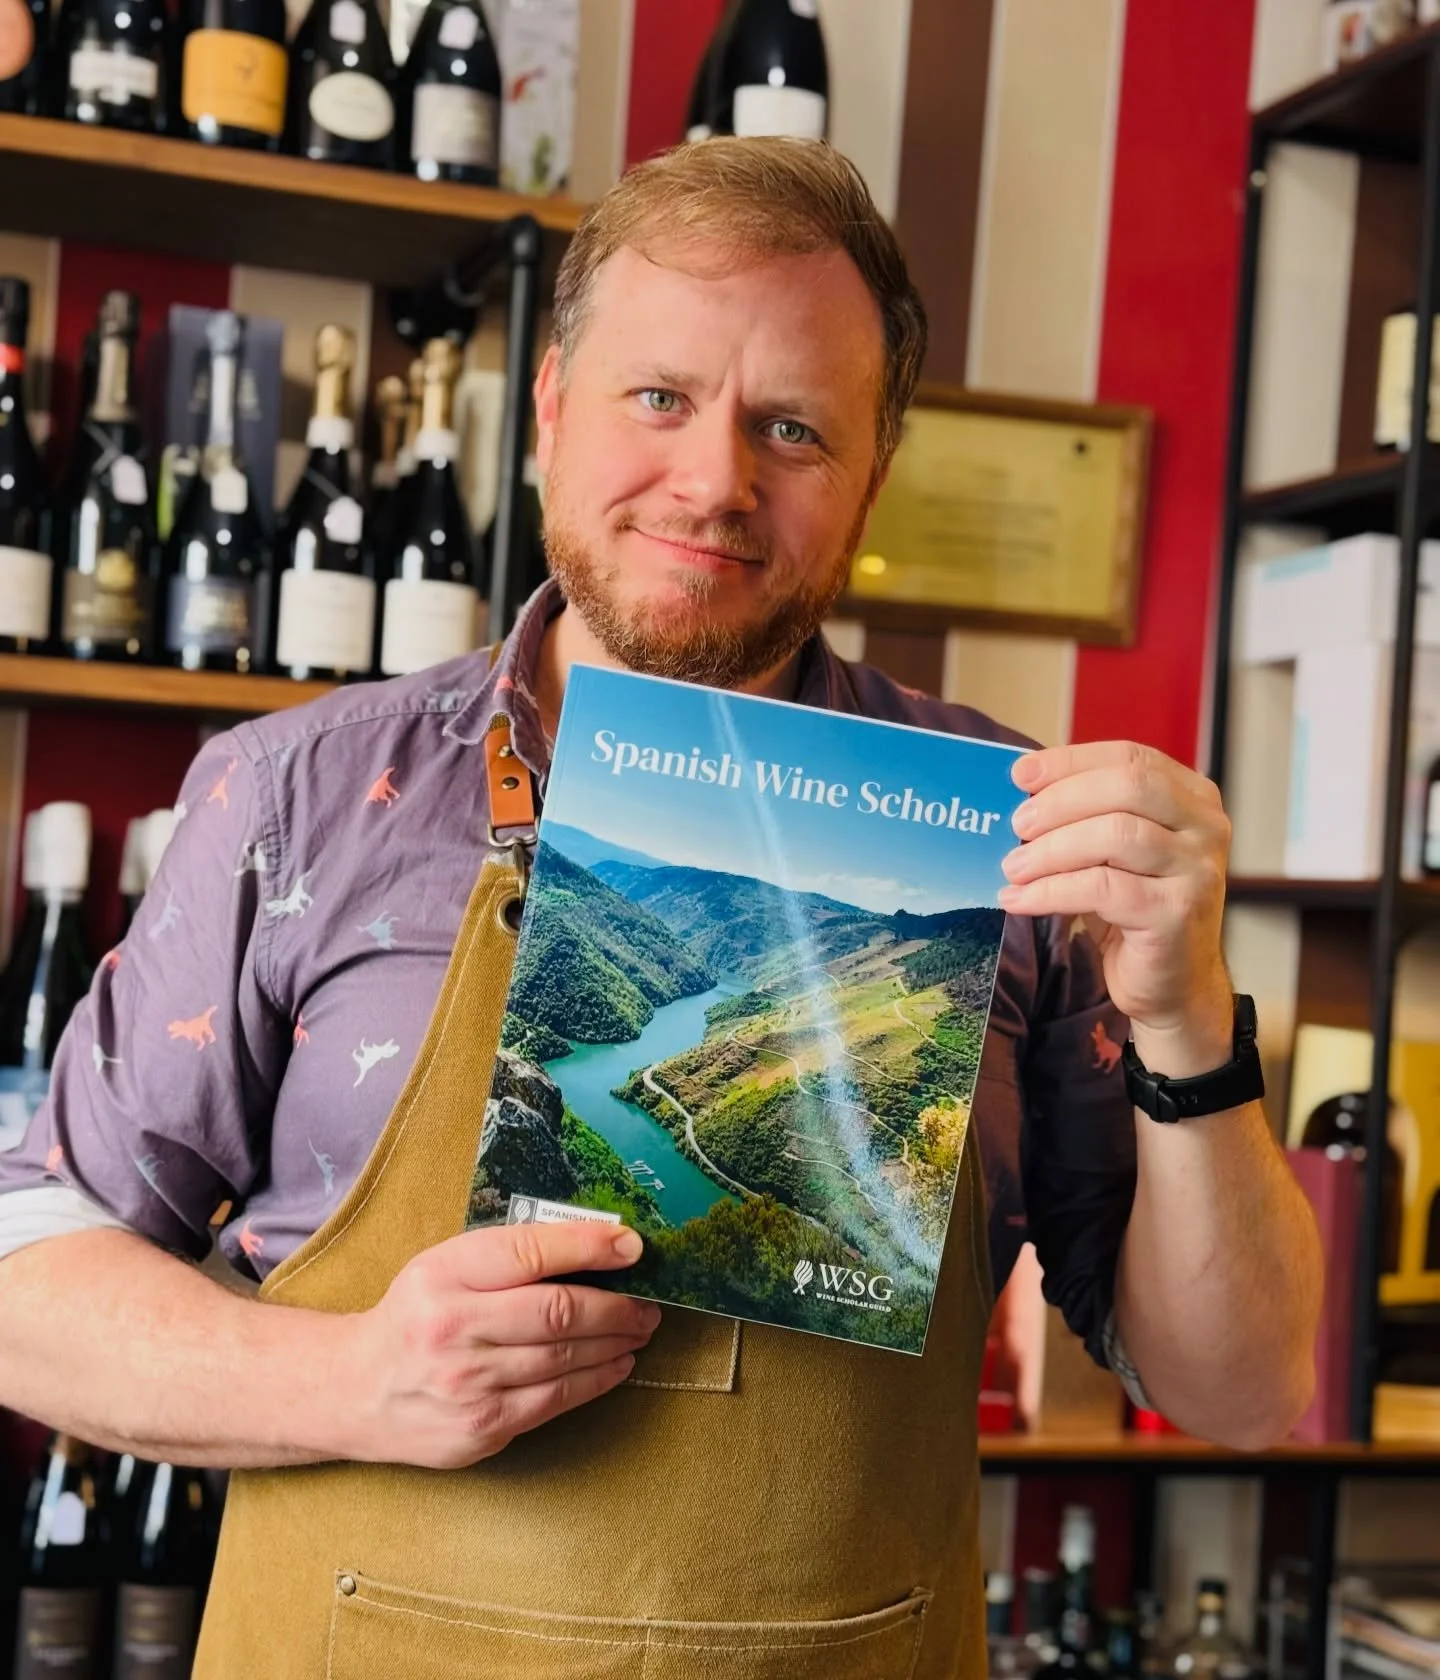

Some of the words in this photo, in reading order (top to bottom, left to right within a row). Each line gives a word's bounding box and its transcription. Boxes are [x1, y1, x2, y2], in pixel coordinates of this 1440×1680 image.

[590, 729, 742, 789] Spanish
[754, 760, 849, 808] Wine
[856, 781, 1001, 836] Scholar
[541, 1207, 587, 1222] SPANISH
[819, 1263, 895, 1301] WSG
[816, 1292, 836, 1302] WINE
[836, 1297, 869, 1308] SCHOLAR
[869, 1303, 892, 1313] GUILD
